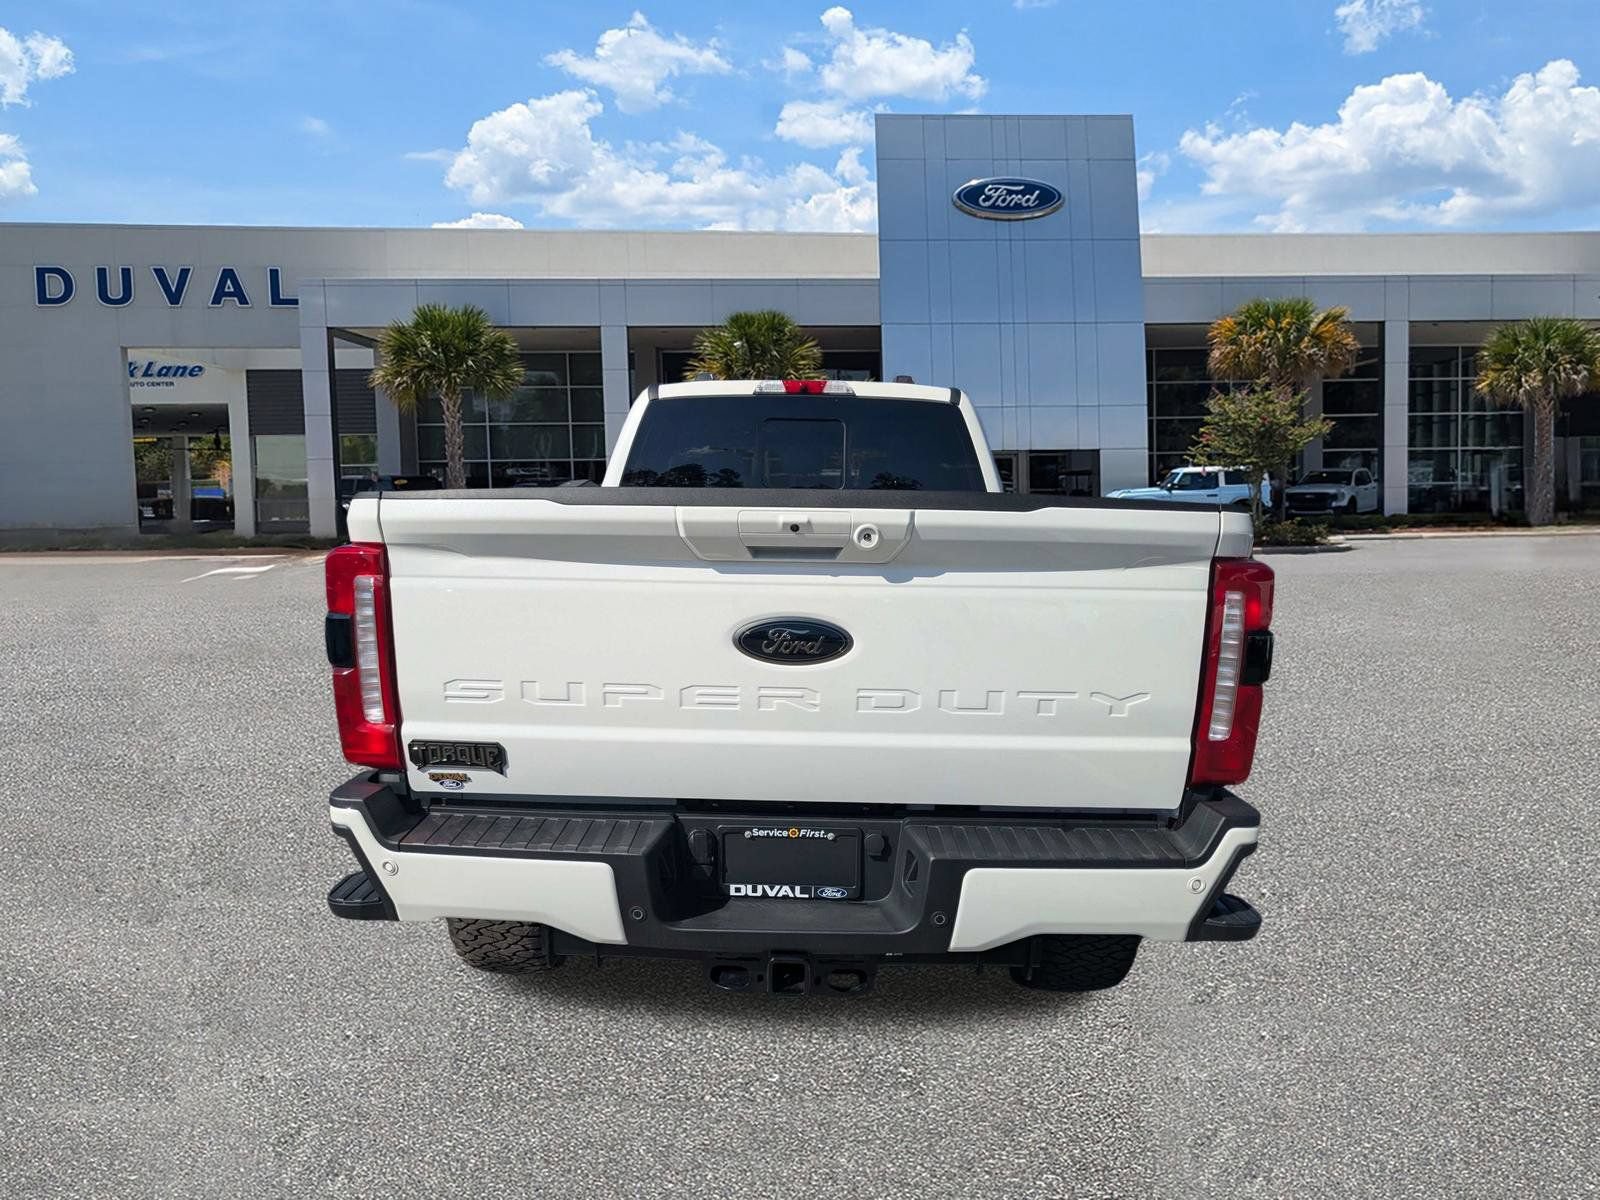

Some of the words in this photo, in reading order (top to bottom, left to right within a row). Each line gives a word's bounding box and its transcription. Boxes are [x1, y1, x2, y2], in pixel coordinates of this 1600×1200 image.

[979, 185, 1040, 207] Ford
[34, 265, 299, 307] DUVAL
[142, 361, 204, 378] Lane
[761, 627, 825, 655] Ford
[443, 678, 821, 713] SUPER
[856, 688, 1151, 718] DUTY
[752, 828, 788, 837] Service
[729, 884, 809, 898] DUVAL
